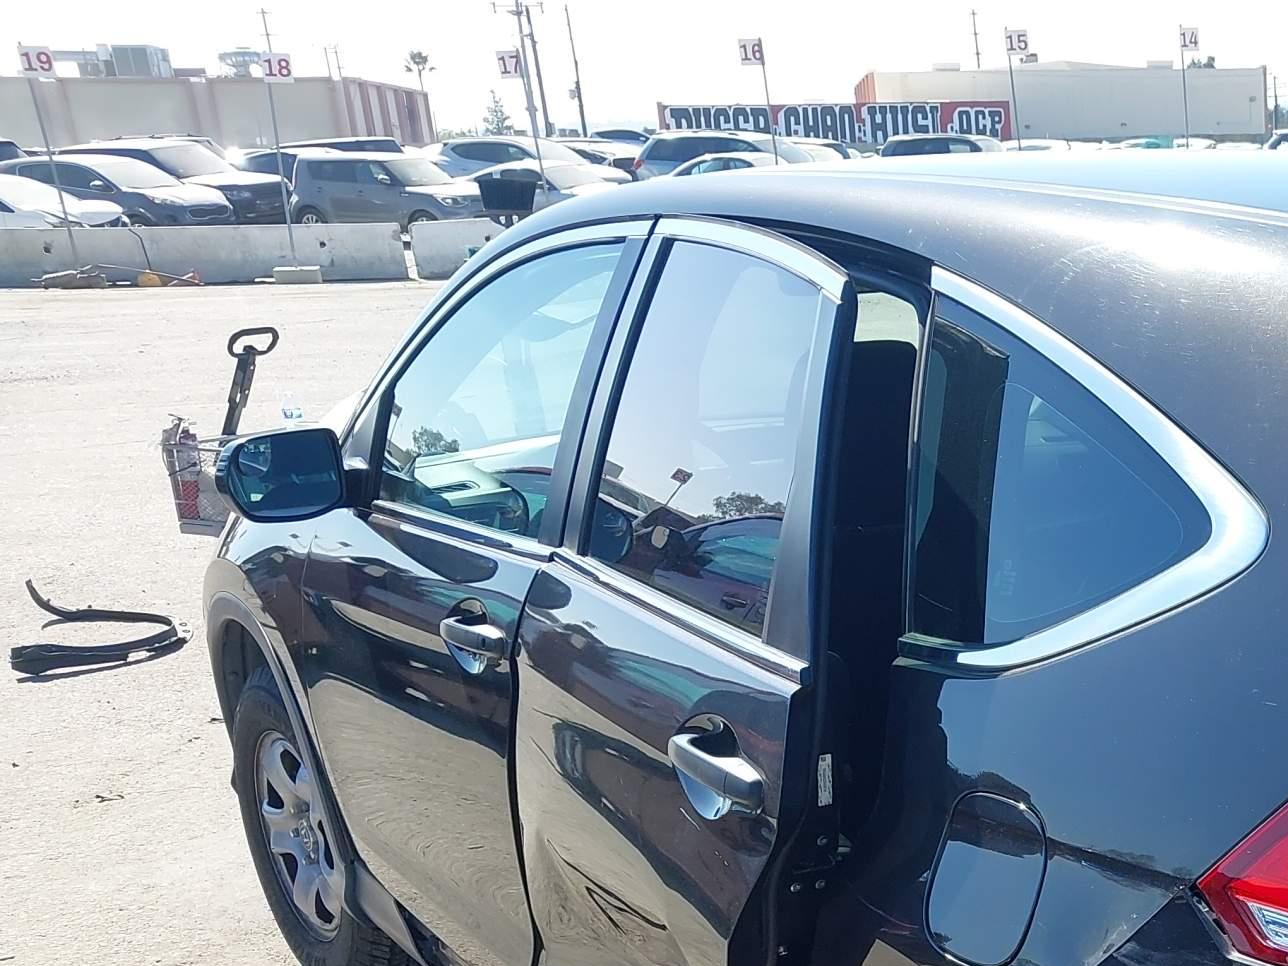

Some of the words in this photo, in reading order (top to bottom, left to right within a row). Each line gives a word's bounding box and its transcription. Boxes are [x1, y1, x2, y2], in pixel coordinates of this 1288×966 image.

[1006, 34, 1028, 51] 15
[1181, 31, 1198, 47] 14
[740, 43, 762, 61] 16
[21, 51, 53, 72] 19
[264, 58, 291, 77] 18
[498, 55, 520, 74] 17
